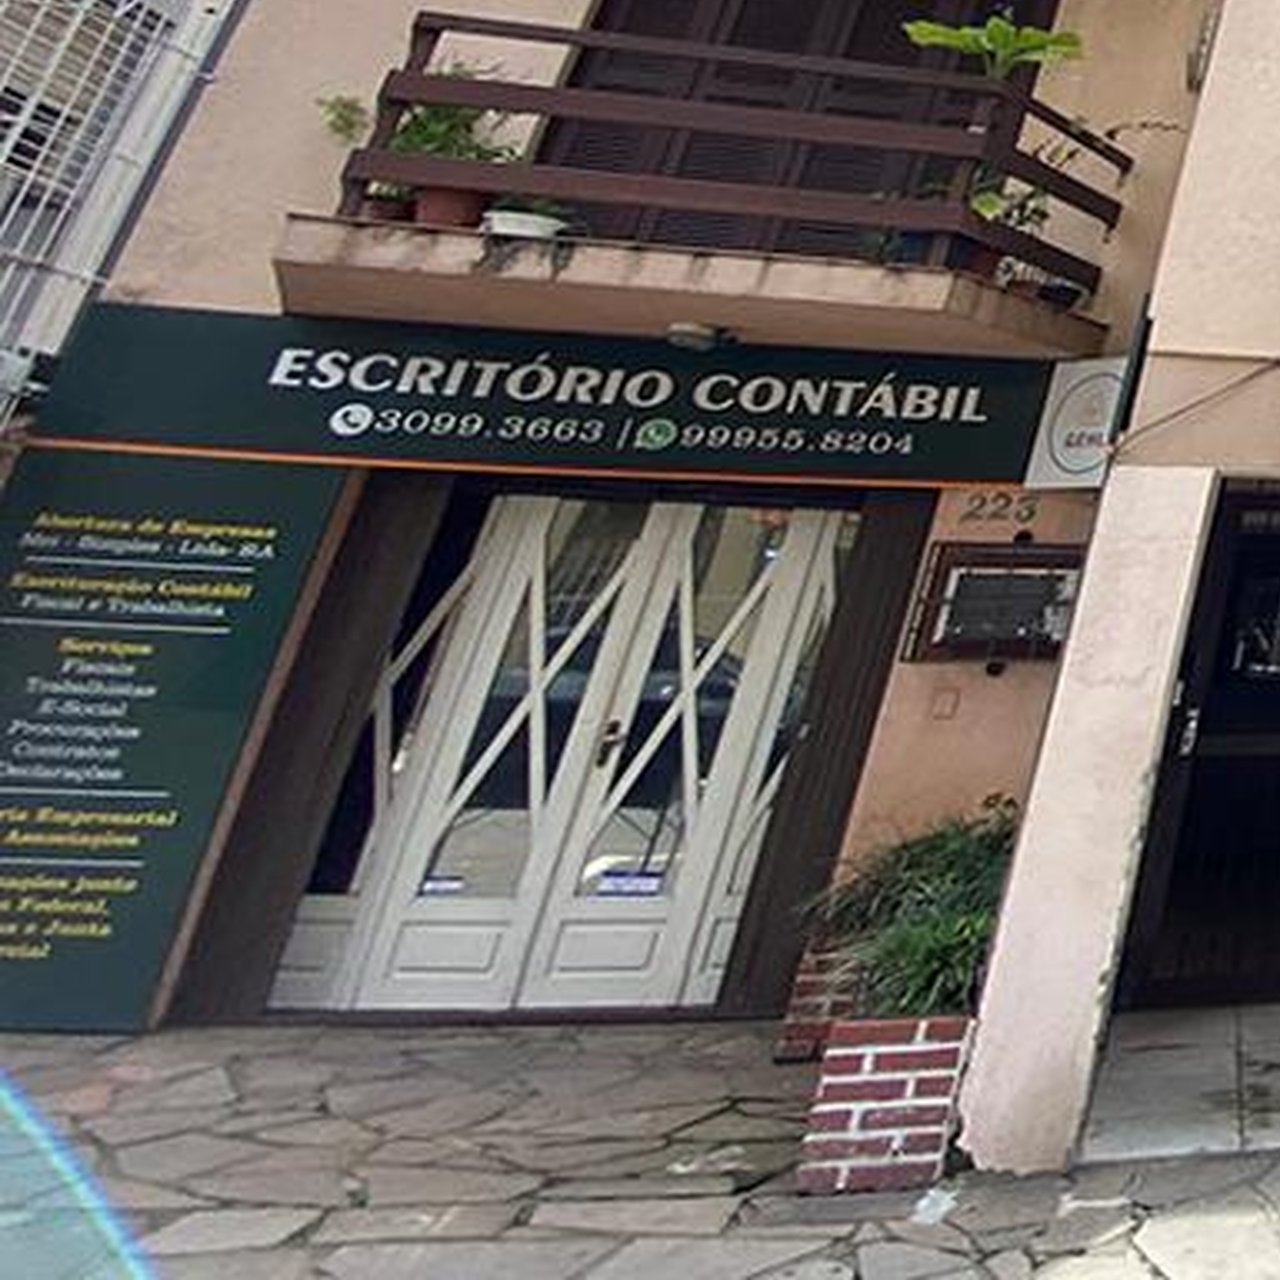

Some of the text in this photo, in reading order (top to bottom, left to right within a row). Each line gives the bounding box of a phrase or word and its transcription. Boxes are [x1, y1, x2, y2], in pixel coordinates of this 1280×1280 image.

[269, 348, 989, 422] ESCRITÓRIO CONTÁBIL
[374, 408, 915, 454] 3099.3663 99955.8204
[959, 491, 1041, 524] 223
